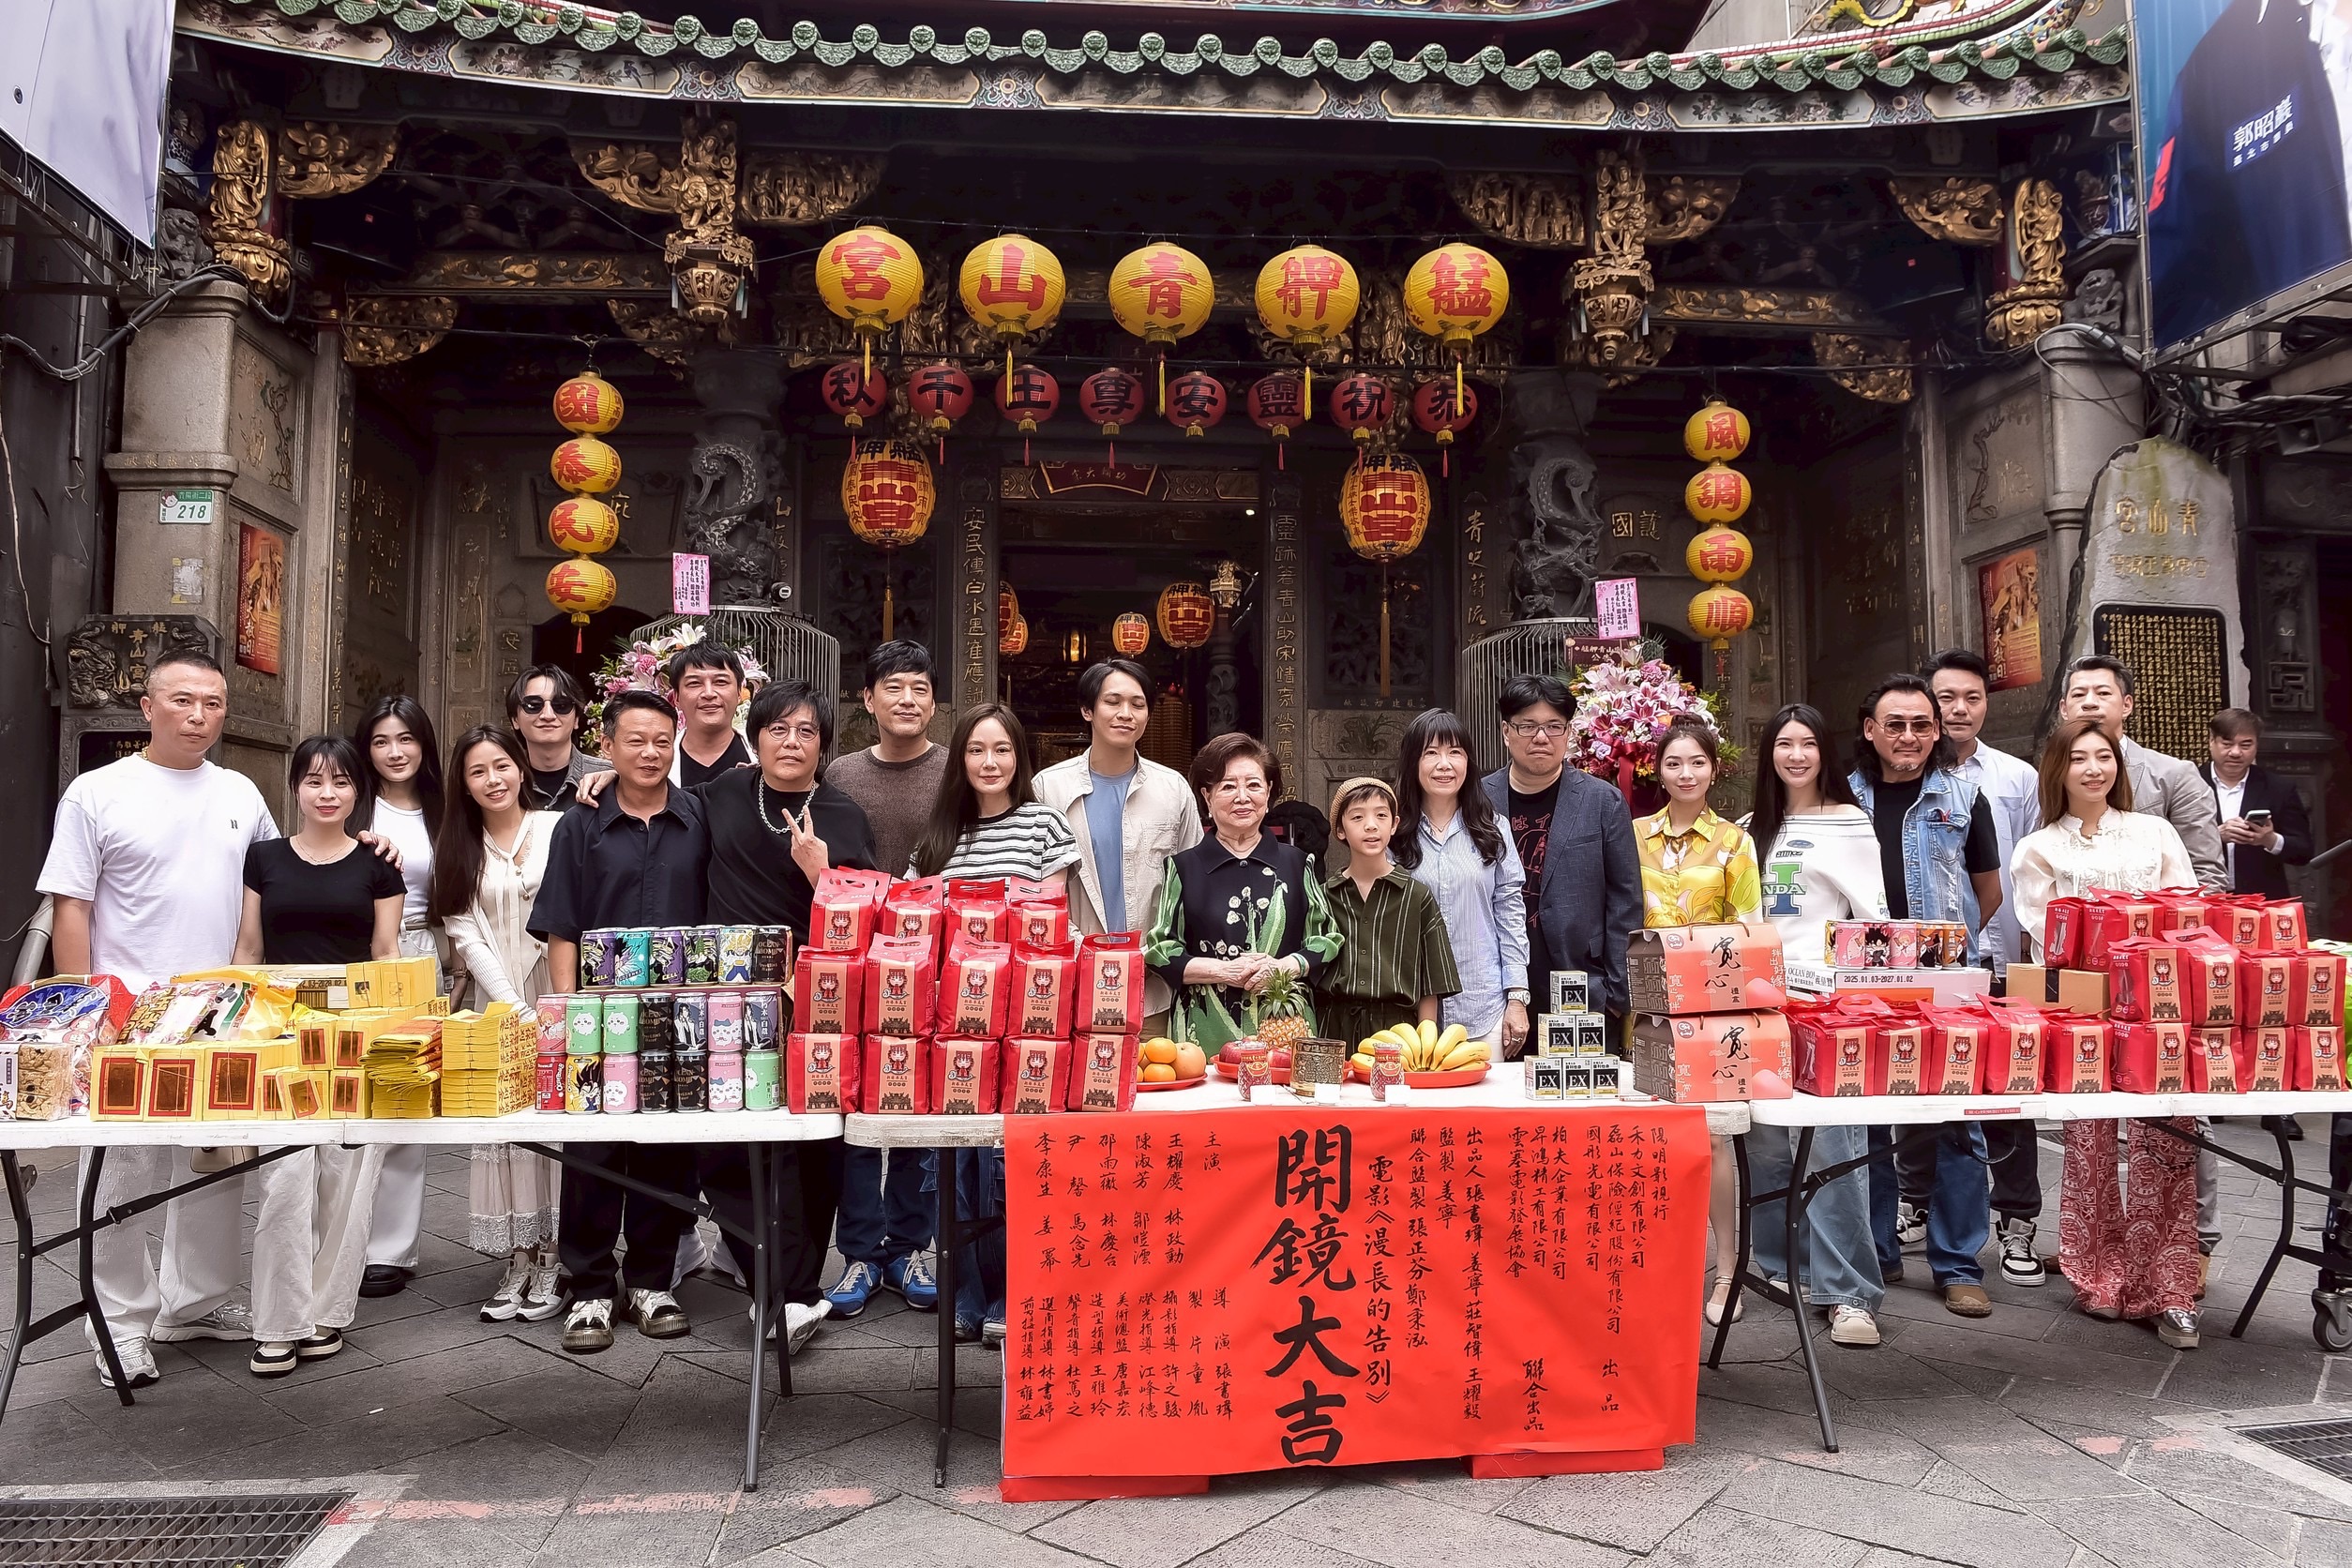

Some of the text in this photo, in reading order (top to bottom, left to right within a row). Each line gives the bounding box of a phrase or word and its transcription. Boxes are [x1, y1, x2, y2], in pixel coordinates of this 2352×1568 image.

[177, 505, 207, 520] 218
[548, 382, 600, 604] 國泰民安
[1696, 411, 1748, 633] 風調雨順
[128, 628, 148, 680] 青山宮
[592, 973, 610, 983] CELL
[661, 972, 679, 981] CELL
[1704, 936, 1741, 988] 寬心
[1564, 989, 1583, 1003] EX
[1551, 1033, 1571, 1045] EX
[1581, 1032, 1600, 1045] EX
[1711, 1025, 1750, 1078] 寬心
[1538, 1075, 1557, 1088] EX
[1569, 1075, 1588, 1087] EX
[1597, 1074, 1616, 1087] EX
[1034, 1132, 1054, 1198] 李康生
[1098, 1133, 1119, 1191] 邵雨薇
[1132, 1132, 1153, 1189] 陳淑芳
[1204, 1134, 1222, 1171] 主演
[1409, 1127, 1431, 1210] 聯合監製
[1439, 1126, 1455, 1172] 監製
[1464, 1126, 1486, 1179] 出品人
[1067, 1135, 1091, 1268] 尹馨 馬念先
[1163, 1133, 1185, 1264] 王耀慶 林政勳
[1550, 1125, 1572, 1280] 柏夫企業有限公司
[1627, 1125, 1647, 1269] 禾力文創有限公司
[1606, 1124, 1626, 1334] 磊山保險經紀股份有限公司
[1250, 1123, 1363, 1467] 開鏡大吉
[1364, 1154, 1395, 1404] 電影《漫長的告別》
[1188, 1289, 1202, 1354] 製片
[1213, 1287, 1230, 1350] 導演
[1091, 1364, 1112, 1417] 王雅玲
[1522, 1357, 1548, 1431] 聯合出品
[1601, 1358, 1619, 1411] 出品
